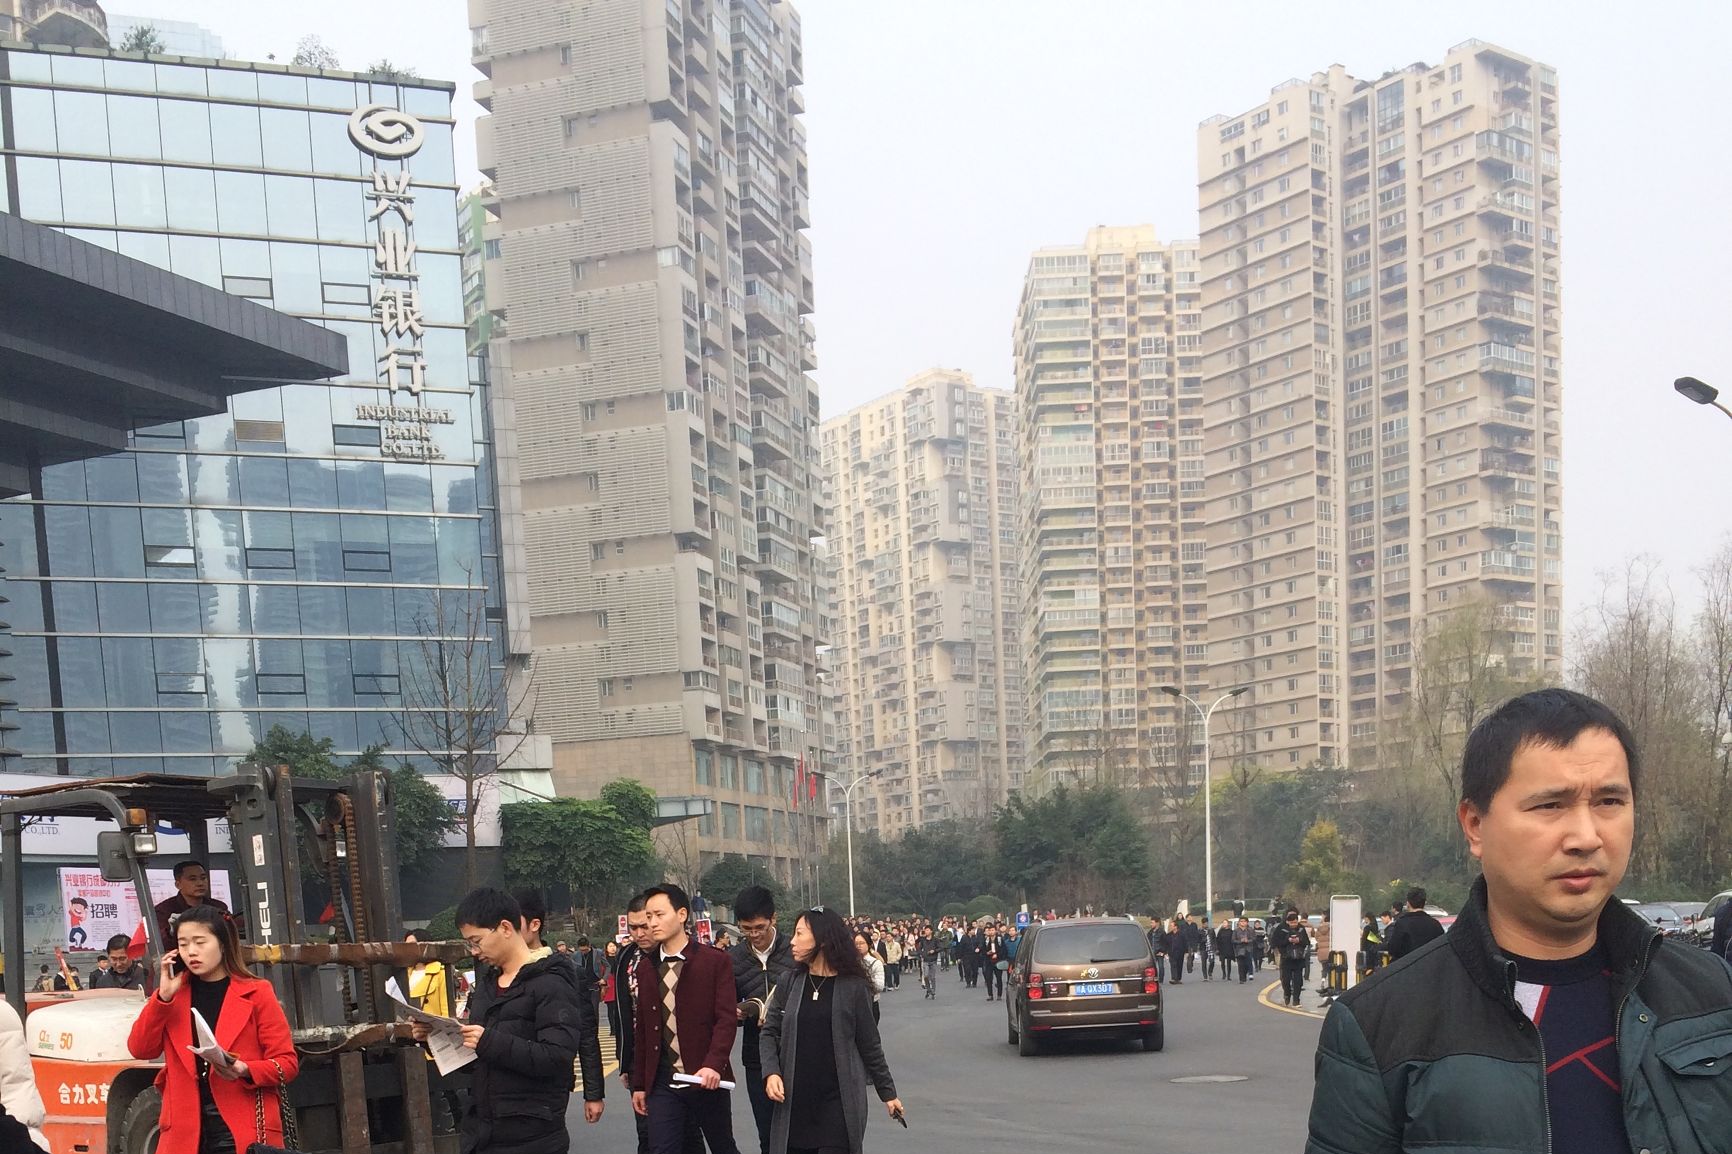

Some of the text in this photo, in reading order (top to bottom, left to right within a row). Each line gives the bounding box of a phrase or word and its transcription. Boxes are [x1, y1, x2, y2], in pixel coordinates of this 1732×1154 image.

[365, 170, 427, 393] 兴业银行
[356, 404, 455, 424] INDUSTRIAL
[385, 422, 431, 440] BANK
[90, 903, 118, 918] 招聘
[257, 882, 272, 946] HELI
[60, 1032, 73, 1050] 50
[58, 1082, 110, 1105] 合力叉车
